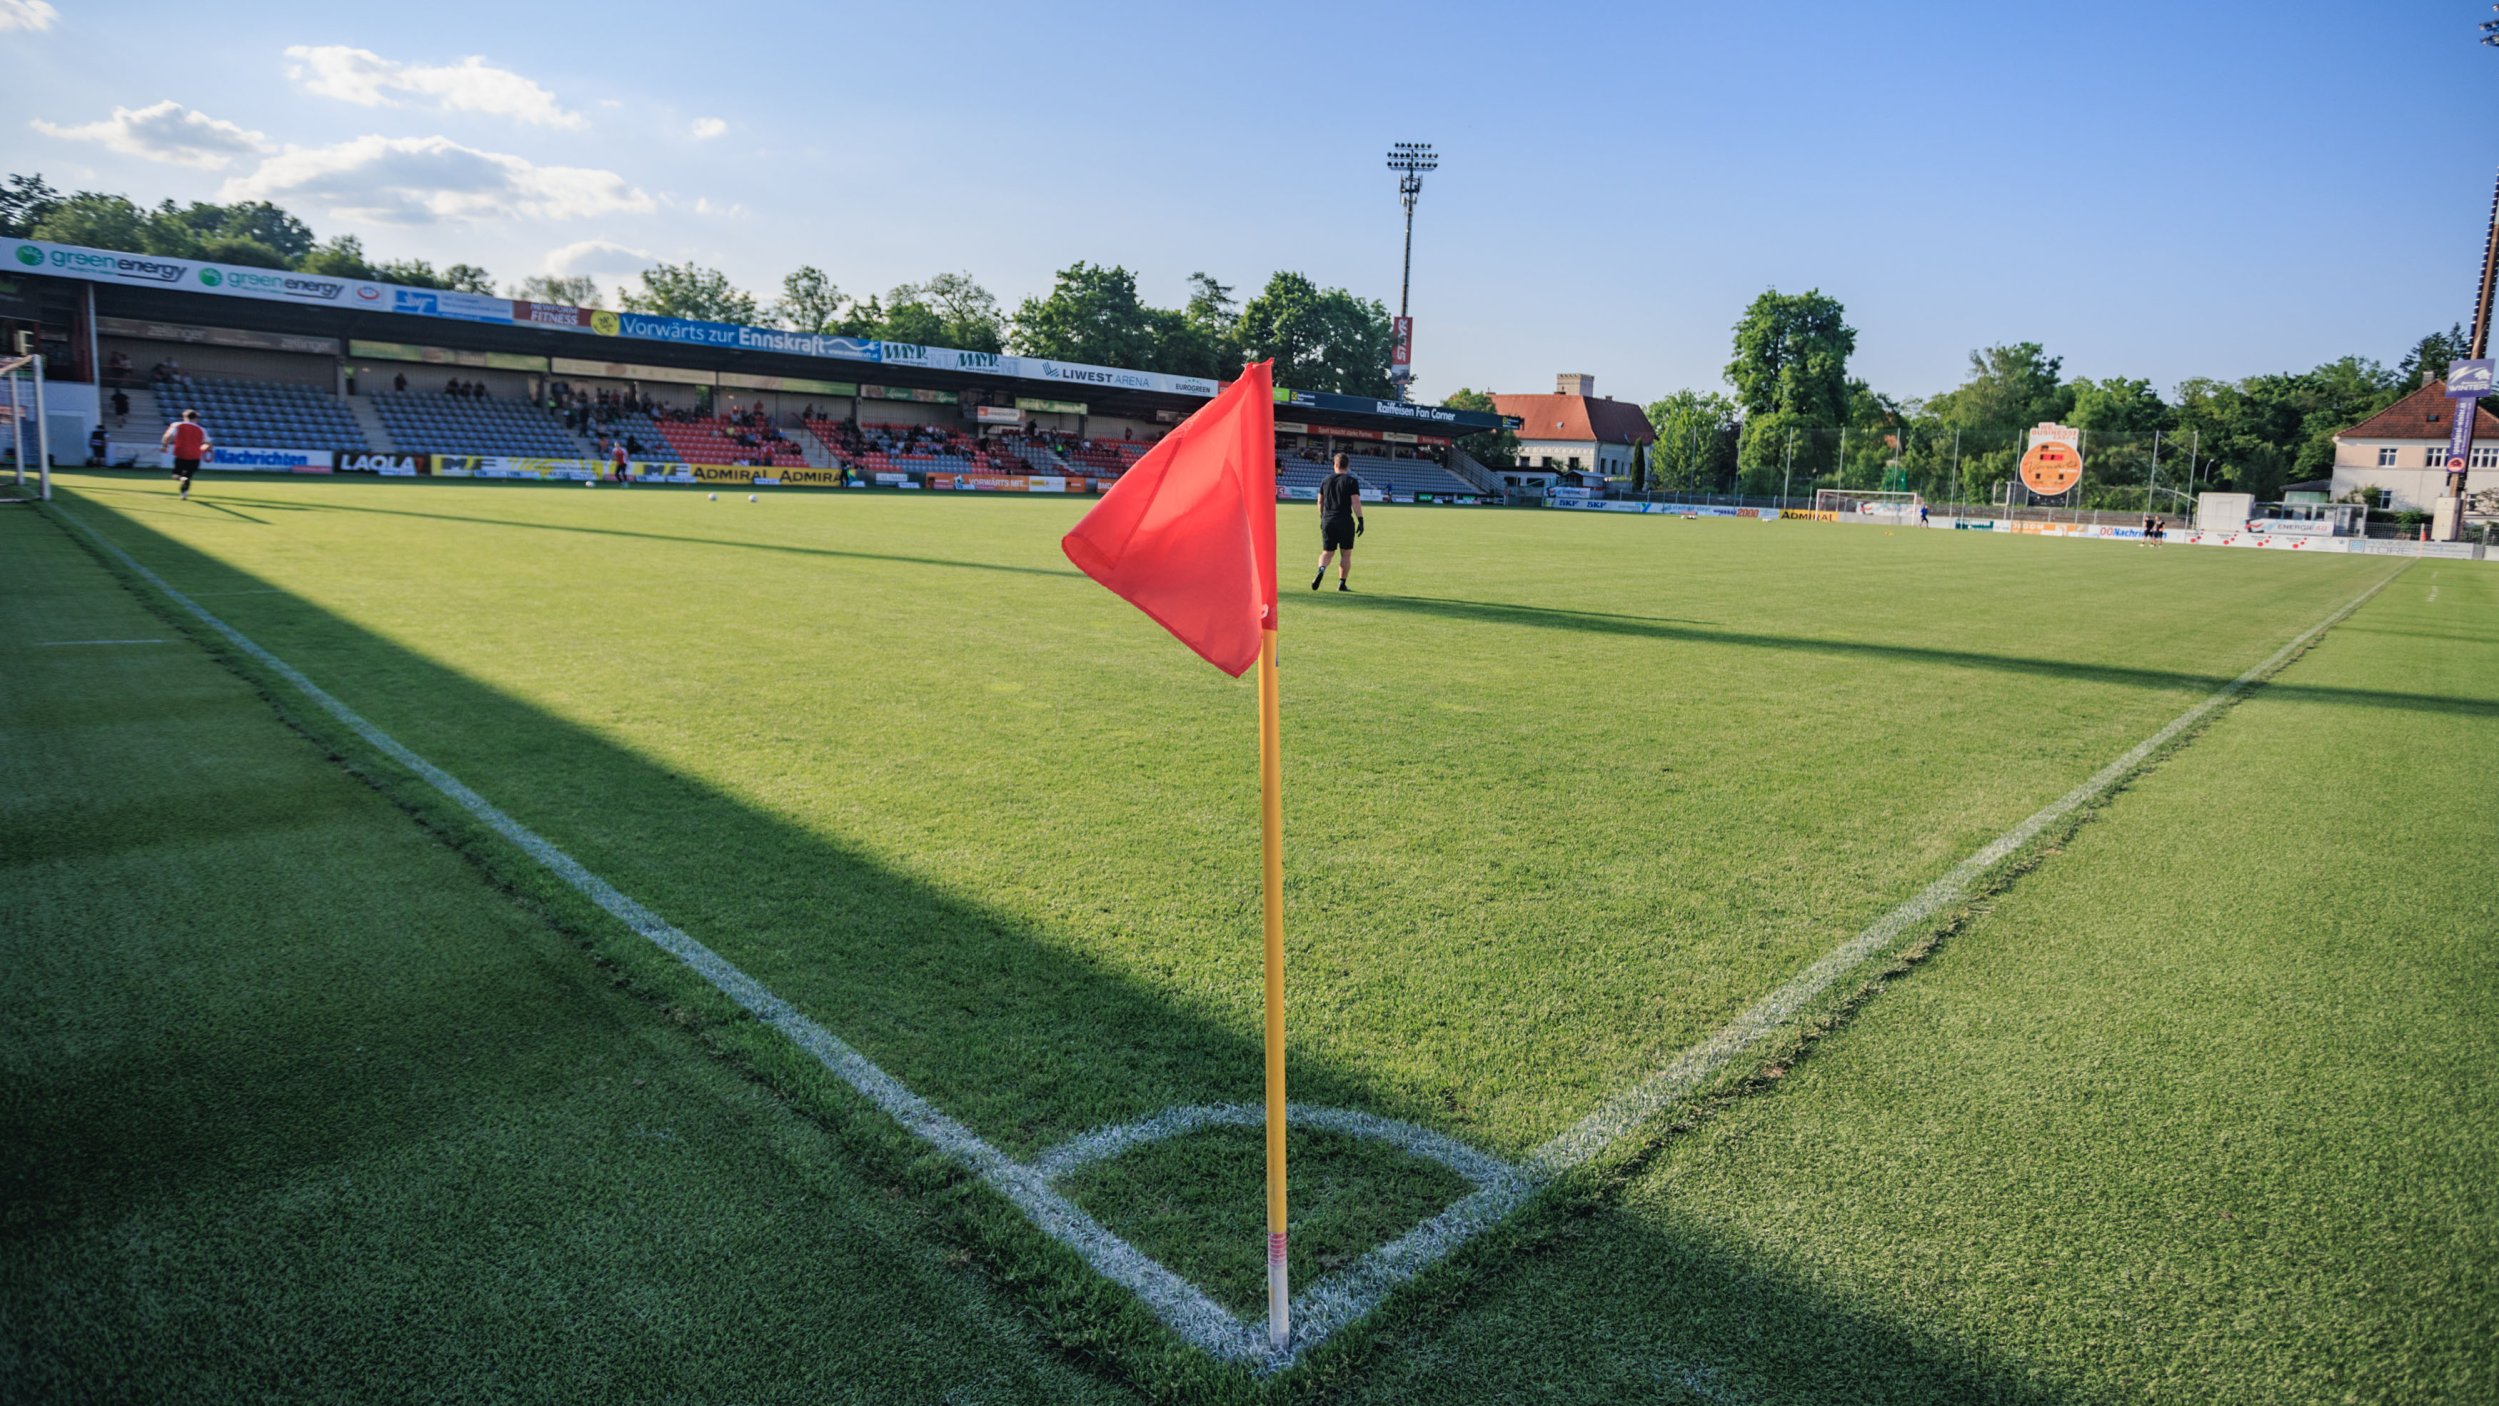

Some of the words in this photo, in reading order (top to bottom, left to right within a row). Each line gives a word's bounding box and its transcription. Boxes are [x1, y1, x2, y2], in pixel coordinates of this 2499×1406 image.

[530, 312, 578, 326] FITNESS
[622, 317, 704, 341] Vorwärts
[708, 328, 735, 343] zur
[738, 327, 825, 356] Ennskraft
[881, 344, 928, 360] MAYR
[954, 352, 1000, 369] MAYR
[1062, 369, 1113, 384] LIWEST
[1114, 374, 1150, 388] ARENA
[1175, 383, 1211, 393] EUROGREEN
[1376, 401, 1414, 417] Raiffeisen
[1415, 406, 1430, 418] Fan
[1431, 408, 1456, 421] Corner
[779, 470, 841, 483] ADMIRA
[1736, 508, 1760, 518] 2000
